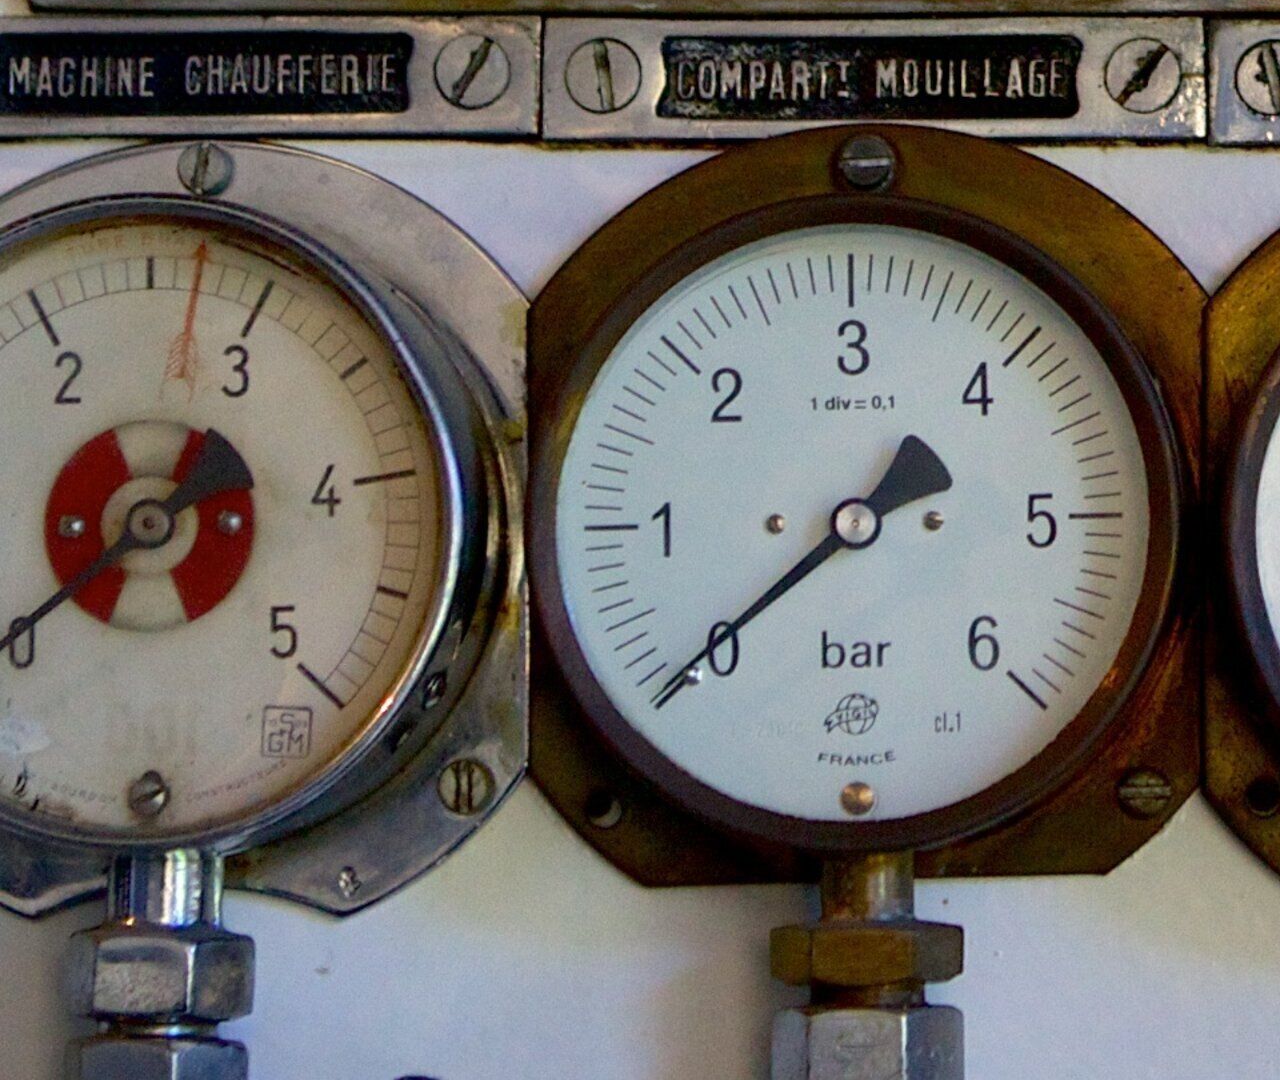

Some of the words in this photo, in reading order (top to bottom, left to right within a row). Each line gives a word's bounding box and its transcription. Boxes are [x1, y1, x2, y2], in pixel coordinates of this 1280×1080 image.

[9, 55, 154, 98] MACHINE
[185, 53, 397, 96] CHAUFFERIE
[876, 58, 1065, 99] MOUILLAGE
[221, 345, 250, 397] 3
[837, 320, 870, 376] 3
[54, 352, 82, 404] 2
[710, 368, 742, 422] 2
[961, 361, 993, 416] 4
[310, 465, 341, 518] 4
[651, 502, 672, 557] 1
[1026, 493, 1057, 547] 5
[9, 616, 35, 669] 0
[269, 605, 297, 658] 5
[706, 621, 740, 677] 0
[821, 632, 891, 669] bar
[968, 615, 1000, 670] 6
[817, 748, 897, 766] FRANCE
